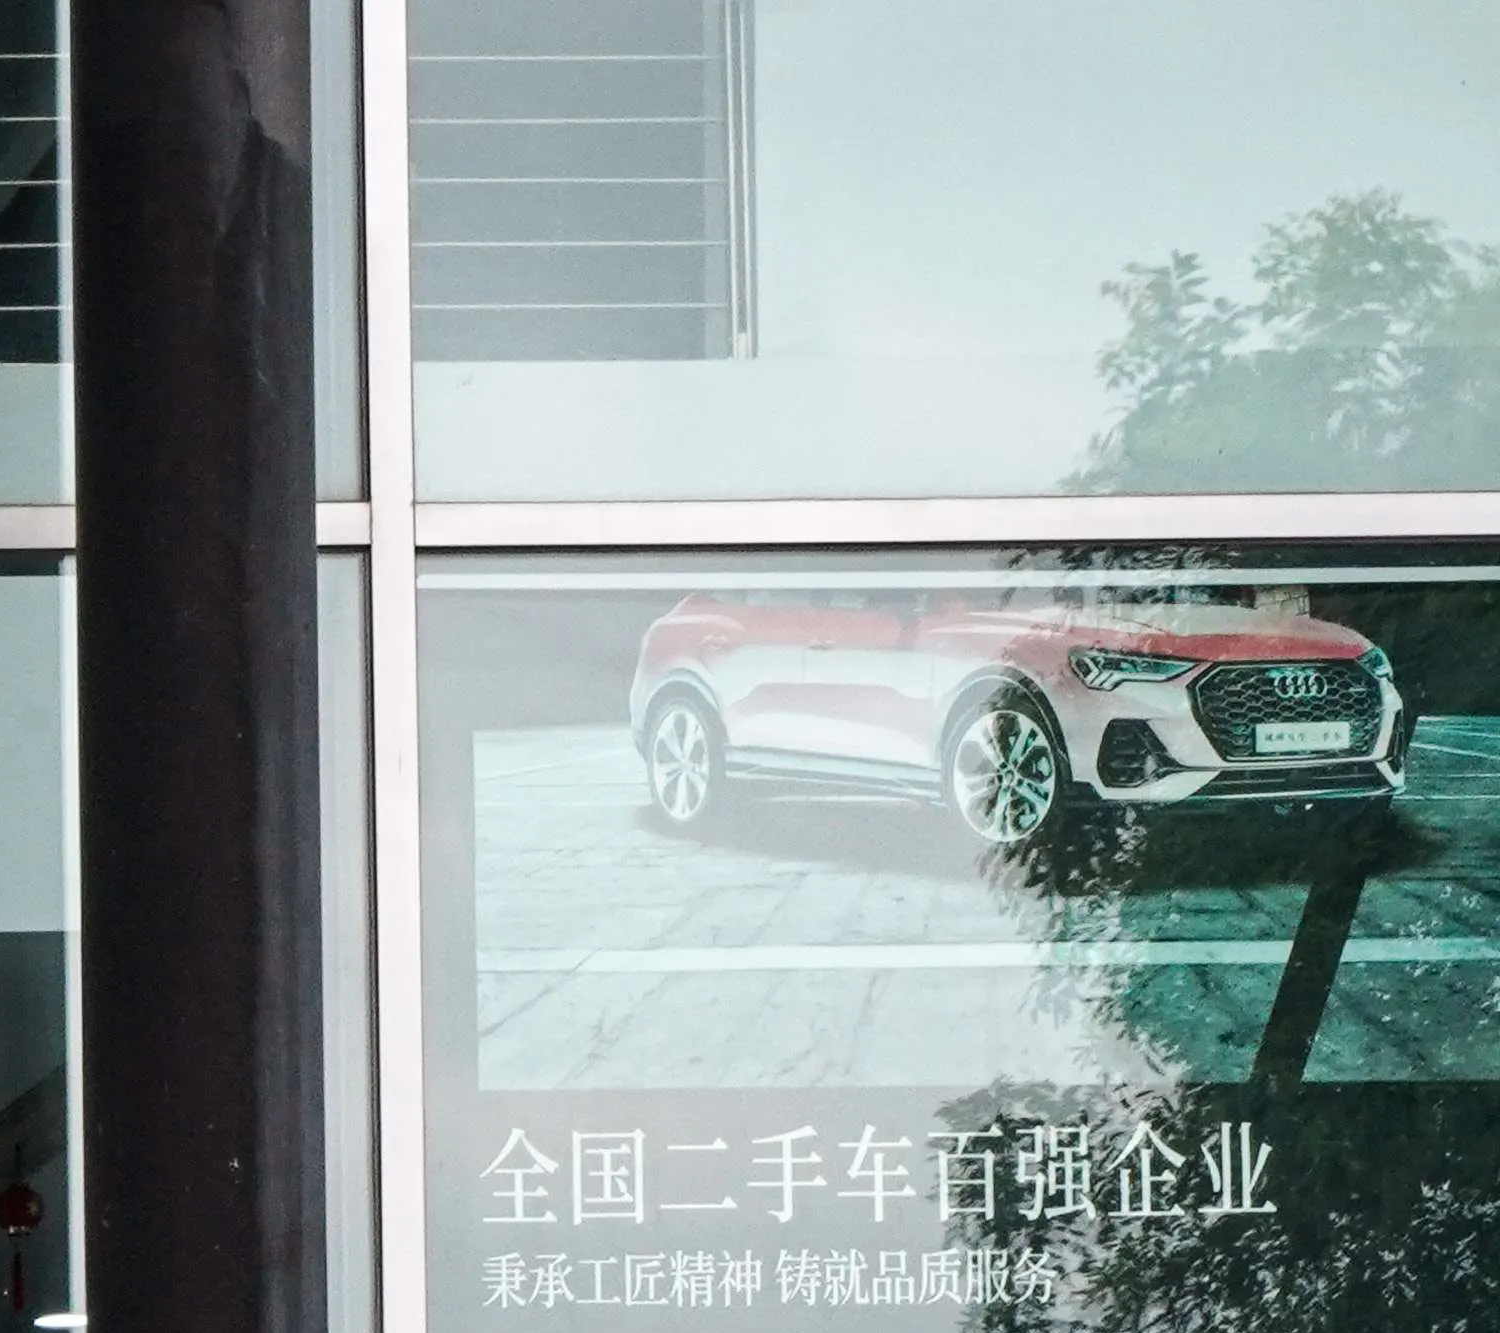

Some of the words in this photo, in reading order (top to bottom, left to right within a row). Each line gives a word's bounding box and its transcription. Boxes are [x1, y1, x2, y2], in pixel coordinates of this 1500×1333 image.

[479, 1121, 1278, 1227] 全国二手车百强企业
[481, 1249, 764, 1309] 秉承工匠精神
[774, 1247, 1059, 1309] 铸就品质服务
